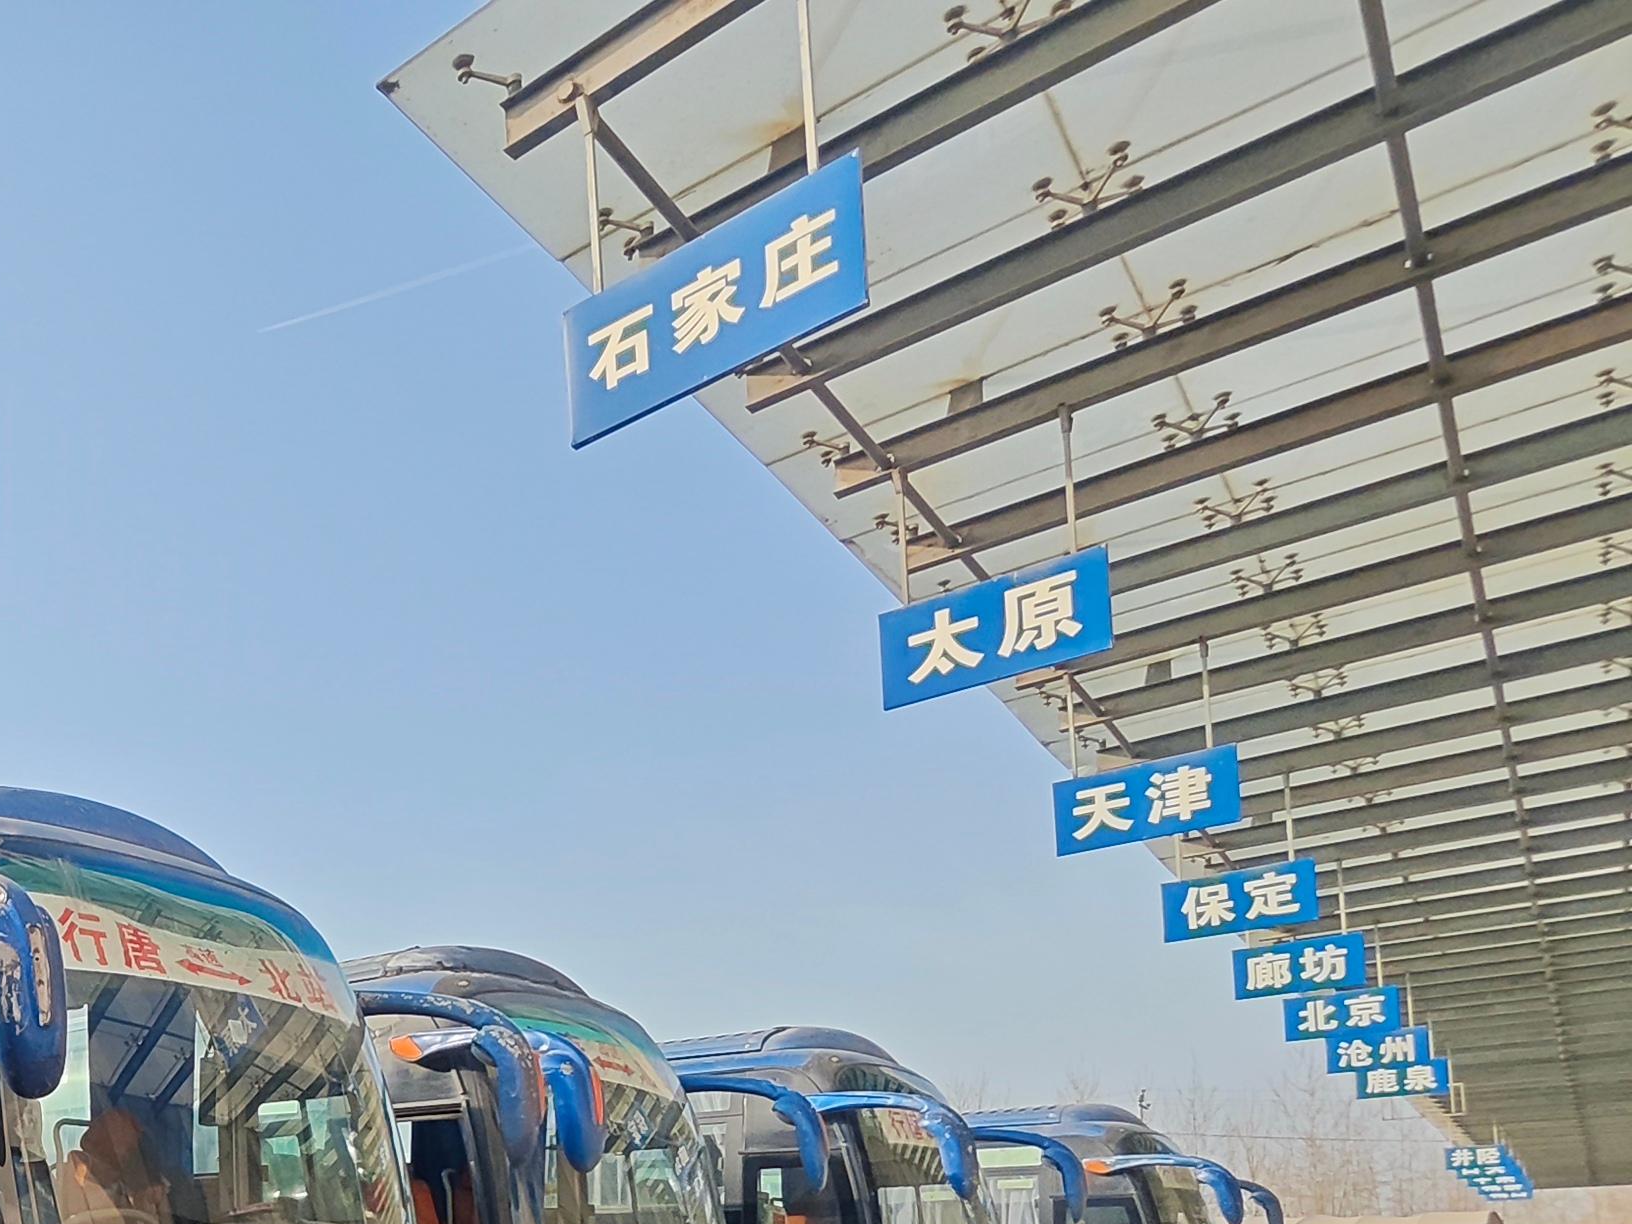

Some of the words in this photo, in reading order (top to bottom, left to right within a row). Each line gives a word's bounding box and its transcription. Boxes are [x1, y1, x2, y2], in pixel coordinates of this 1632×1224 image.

[587, 207, 840, 391] 石家庄
[907, 569, 1084, 686] 太原
[1071, 764, 1213, 841] 天津
[1179, 871, 1302, 930] 保定
[57, 907, 167, 975] 行唐
[1245, 943, 1348, 991] 廊坊
[1297, 993, 1387, 1032] 北京
[1336, 1033, 1415, 1068] 沧州
[1365, 1064, 1438, 1095] 鹿泉
